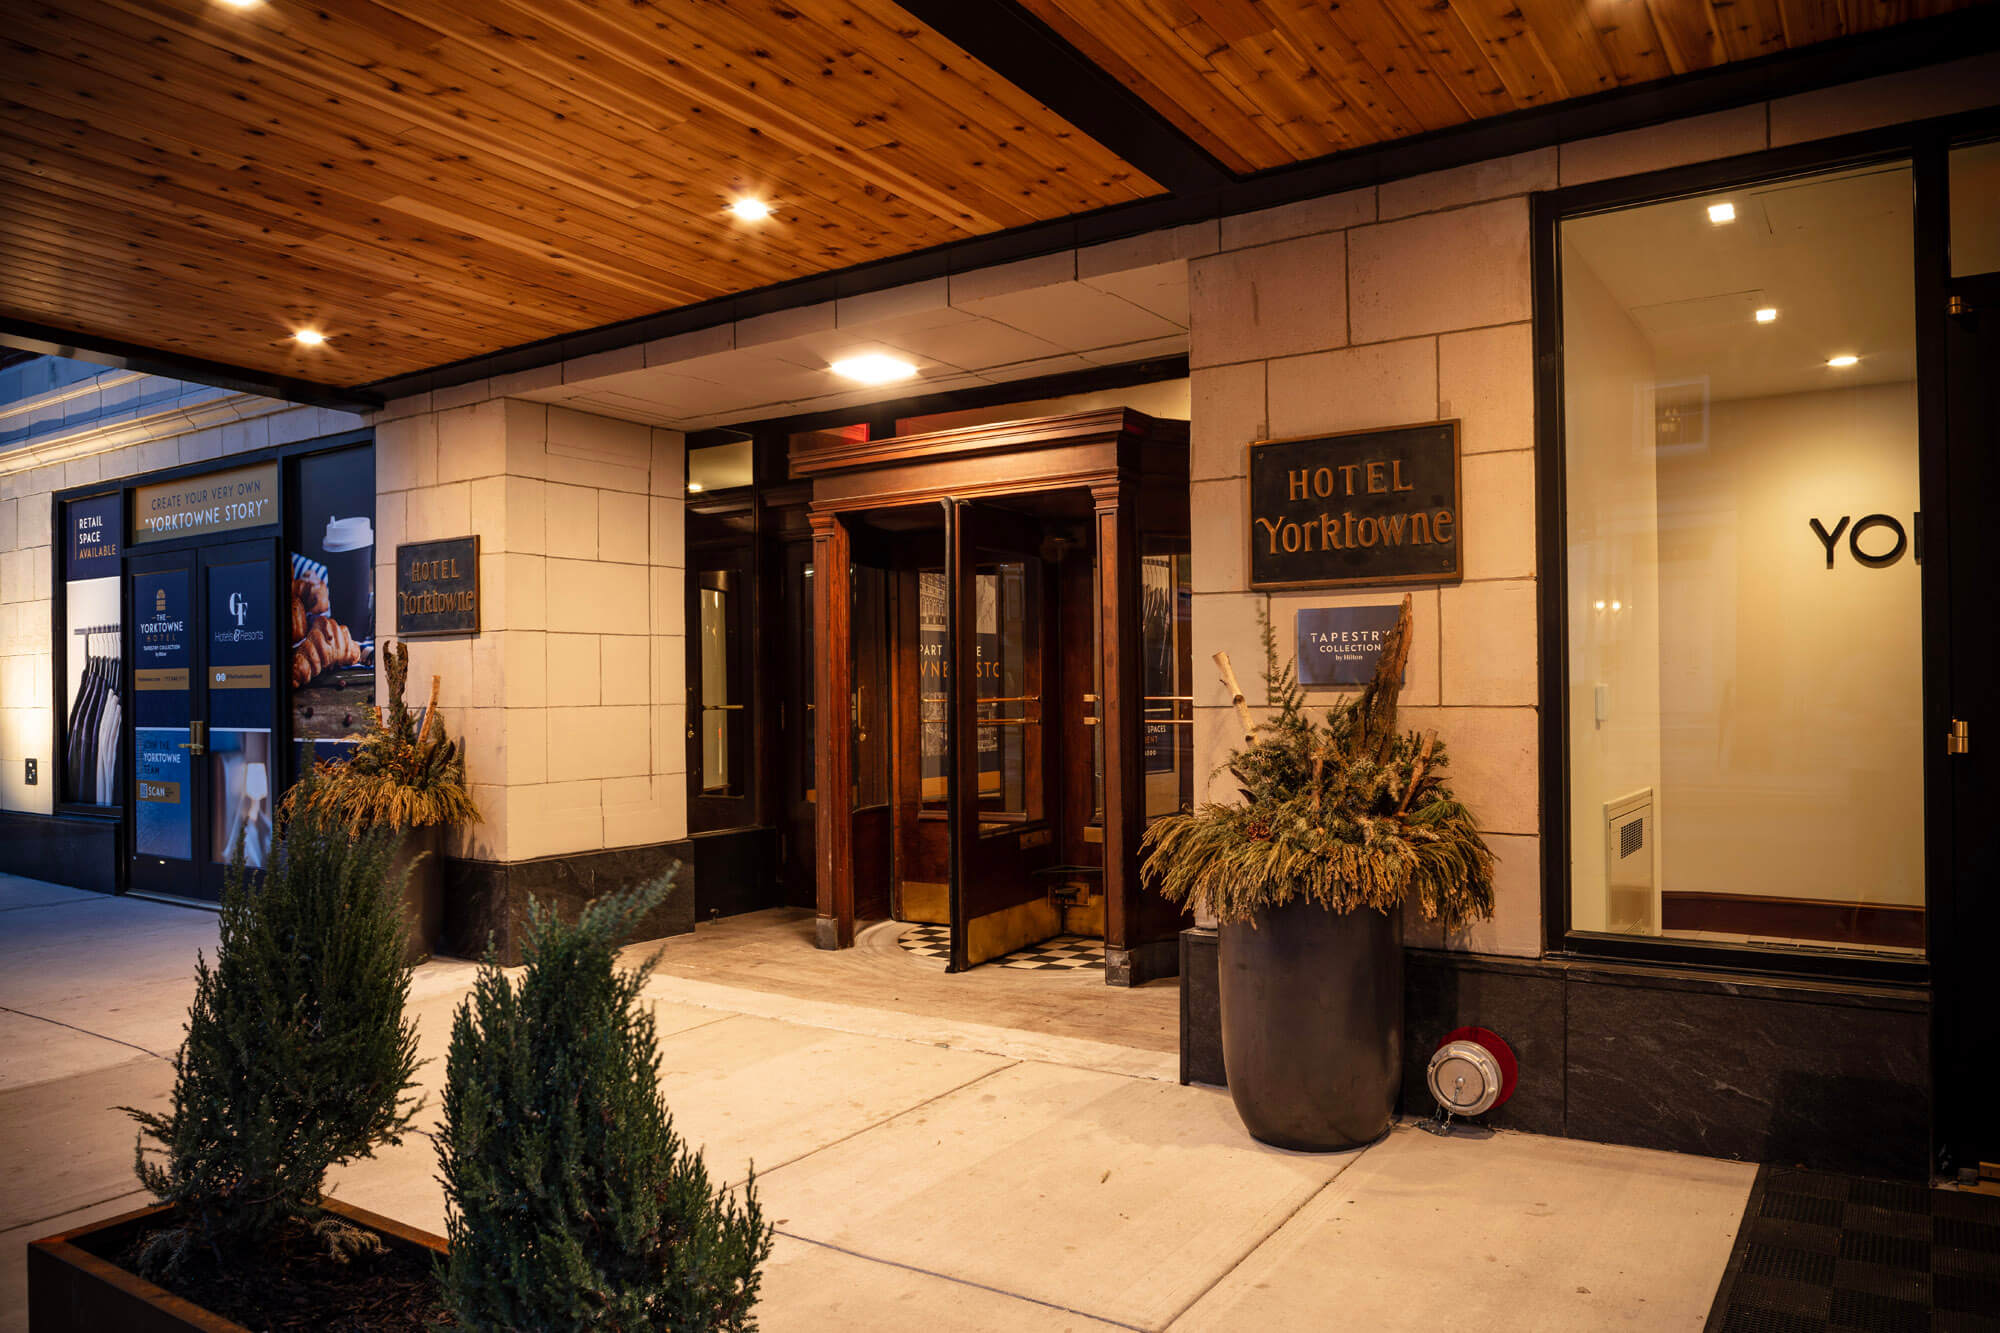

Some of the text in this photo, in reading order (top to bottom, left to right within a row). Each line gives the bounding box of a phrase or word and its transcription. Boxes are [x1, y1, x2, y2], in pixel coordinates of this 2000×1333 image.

[1288, 459, 1415, 501] HOTEL
[152, 480, 261, 510] CREATE YOUR VERY OWN
[79, 515, 103, 529] RETAIL
[79, 531, 101, 544] SPACE
[1255, 510, 1453, 555] Yorktowne
[1809, 512, 1921, 569] YO
[79, 544, 117, 560] AVAILABLE
[411, 558, 461, 583] HOTEL
[399, 590, 474, 616] Yorktowne
[156, 613, 167, 621] THE
[140, 621, 184, 634] YORKTOWNE
[1320, 643, 1381, 653] COLLECTION
[144, 752, 182, 764] YORKTOWNE
[148, 784, 165, 797] SCAN
